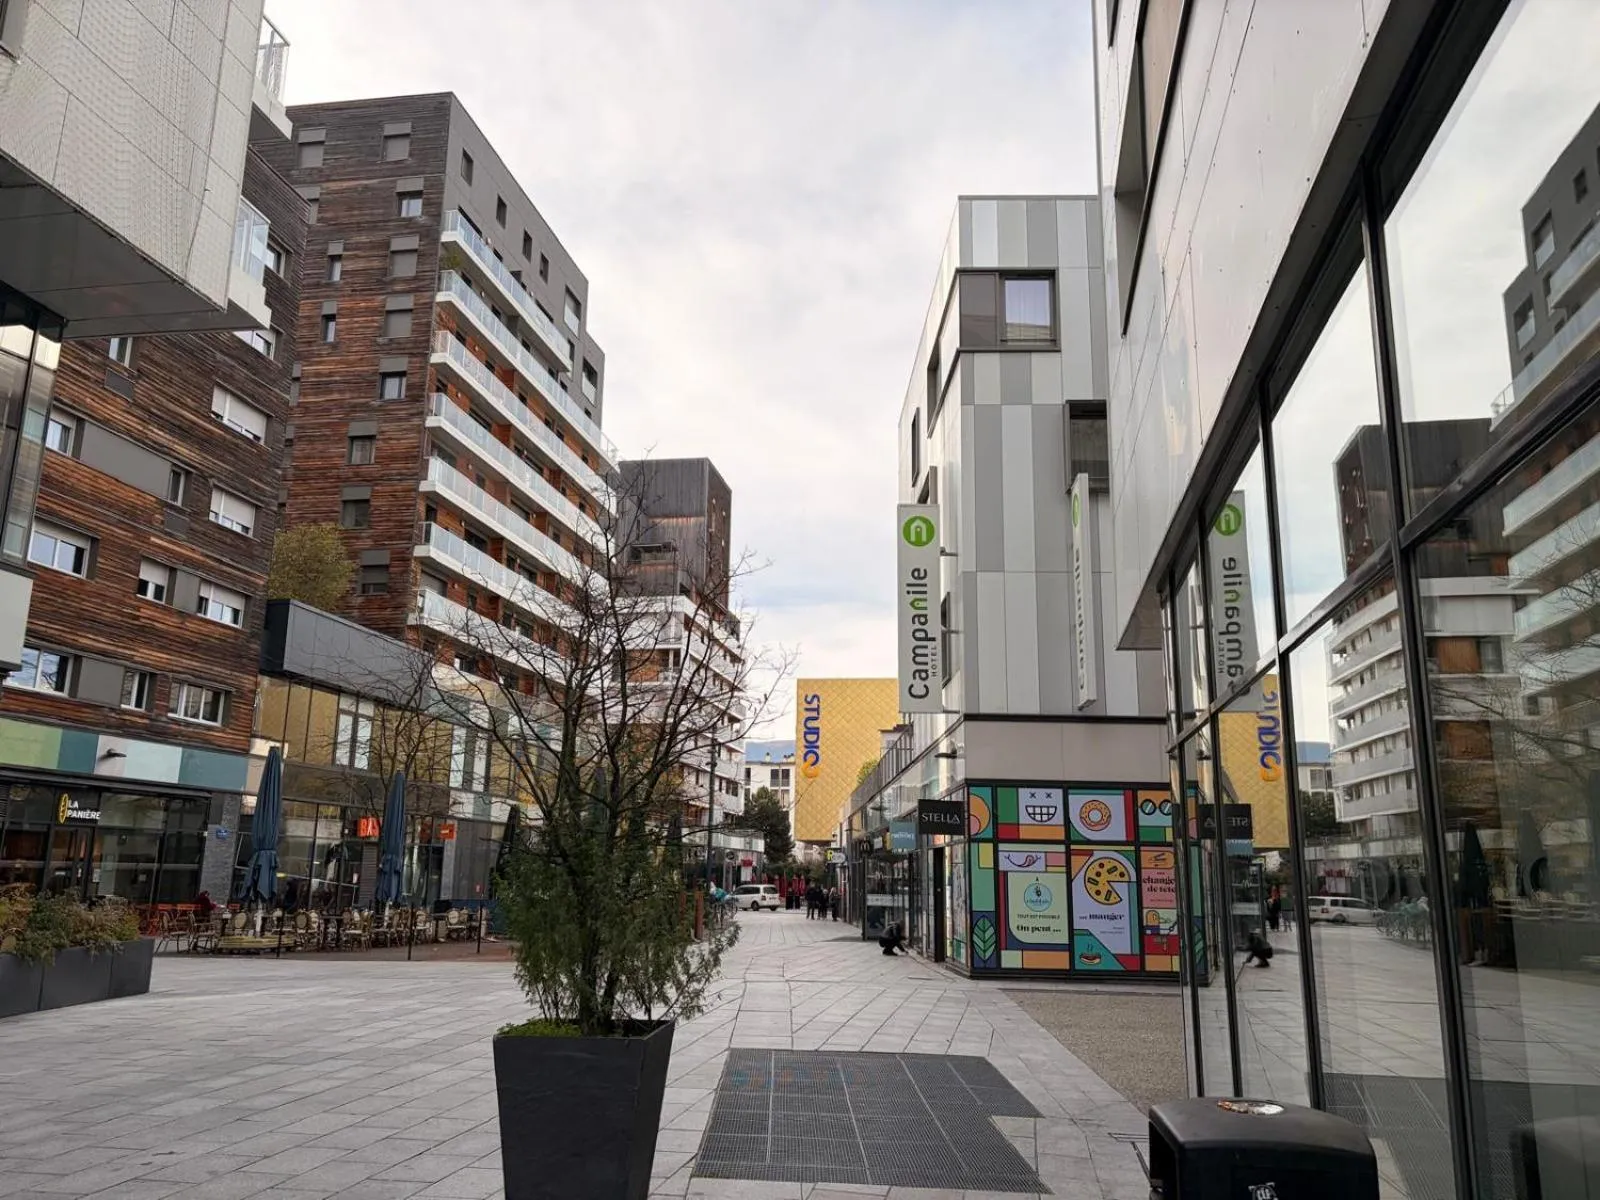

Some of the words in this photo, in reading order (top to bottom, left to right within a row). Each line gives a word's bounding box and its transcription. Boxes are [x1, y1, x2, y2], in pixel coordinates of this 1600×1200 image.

[906, 567, 936, 699] Campanile
[68, 800, 79, 808] LA
[67, 809, 101, 820] PANIÈRE
[921, 812, 960, 824] STELLA
